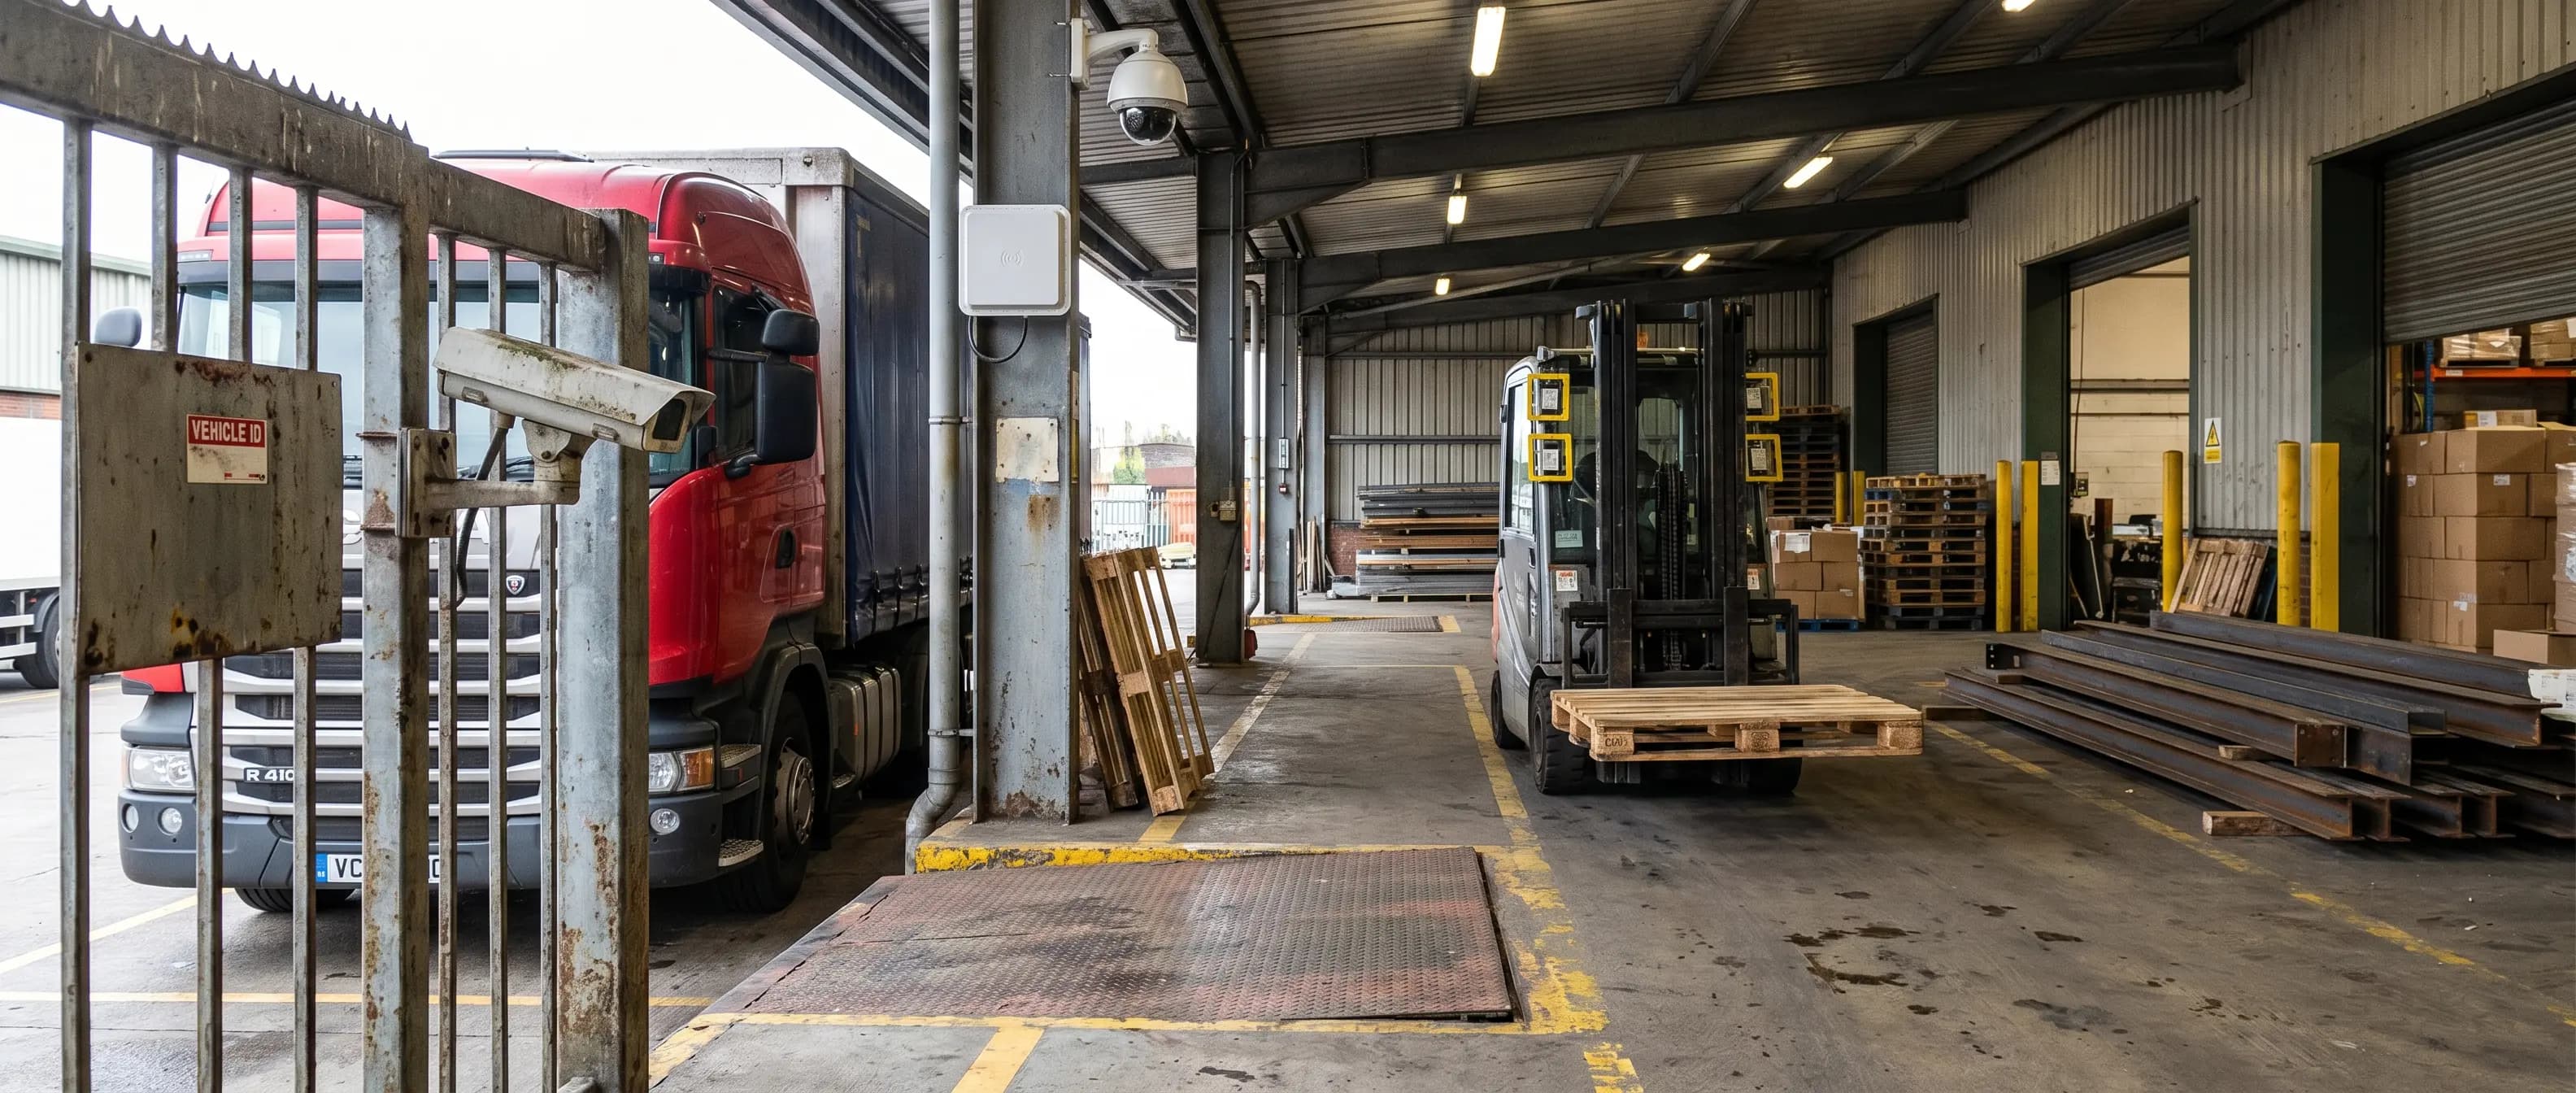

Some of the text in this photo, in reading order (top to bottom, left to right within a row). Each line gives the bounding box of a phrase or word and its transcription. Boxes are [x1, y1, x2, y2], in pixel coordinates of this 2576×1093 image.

[192, 420, 261, 443] VEHICLE ID
[246, 769, 294, 781] R 410
